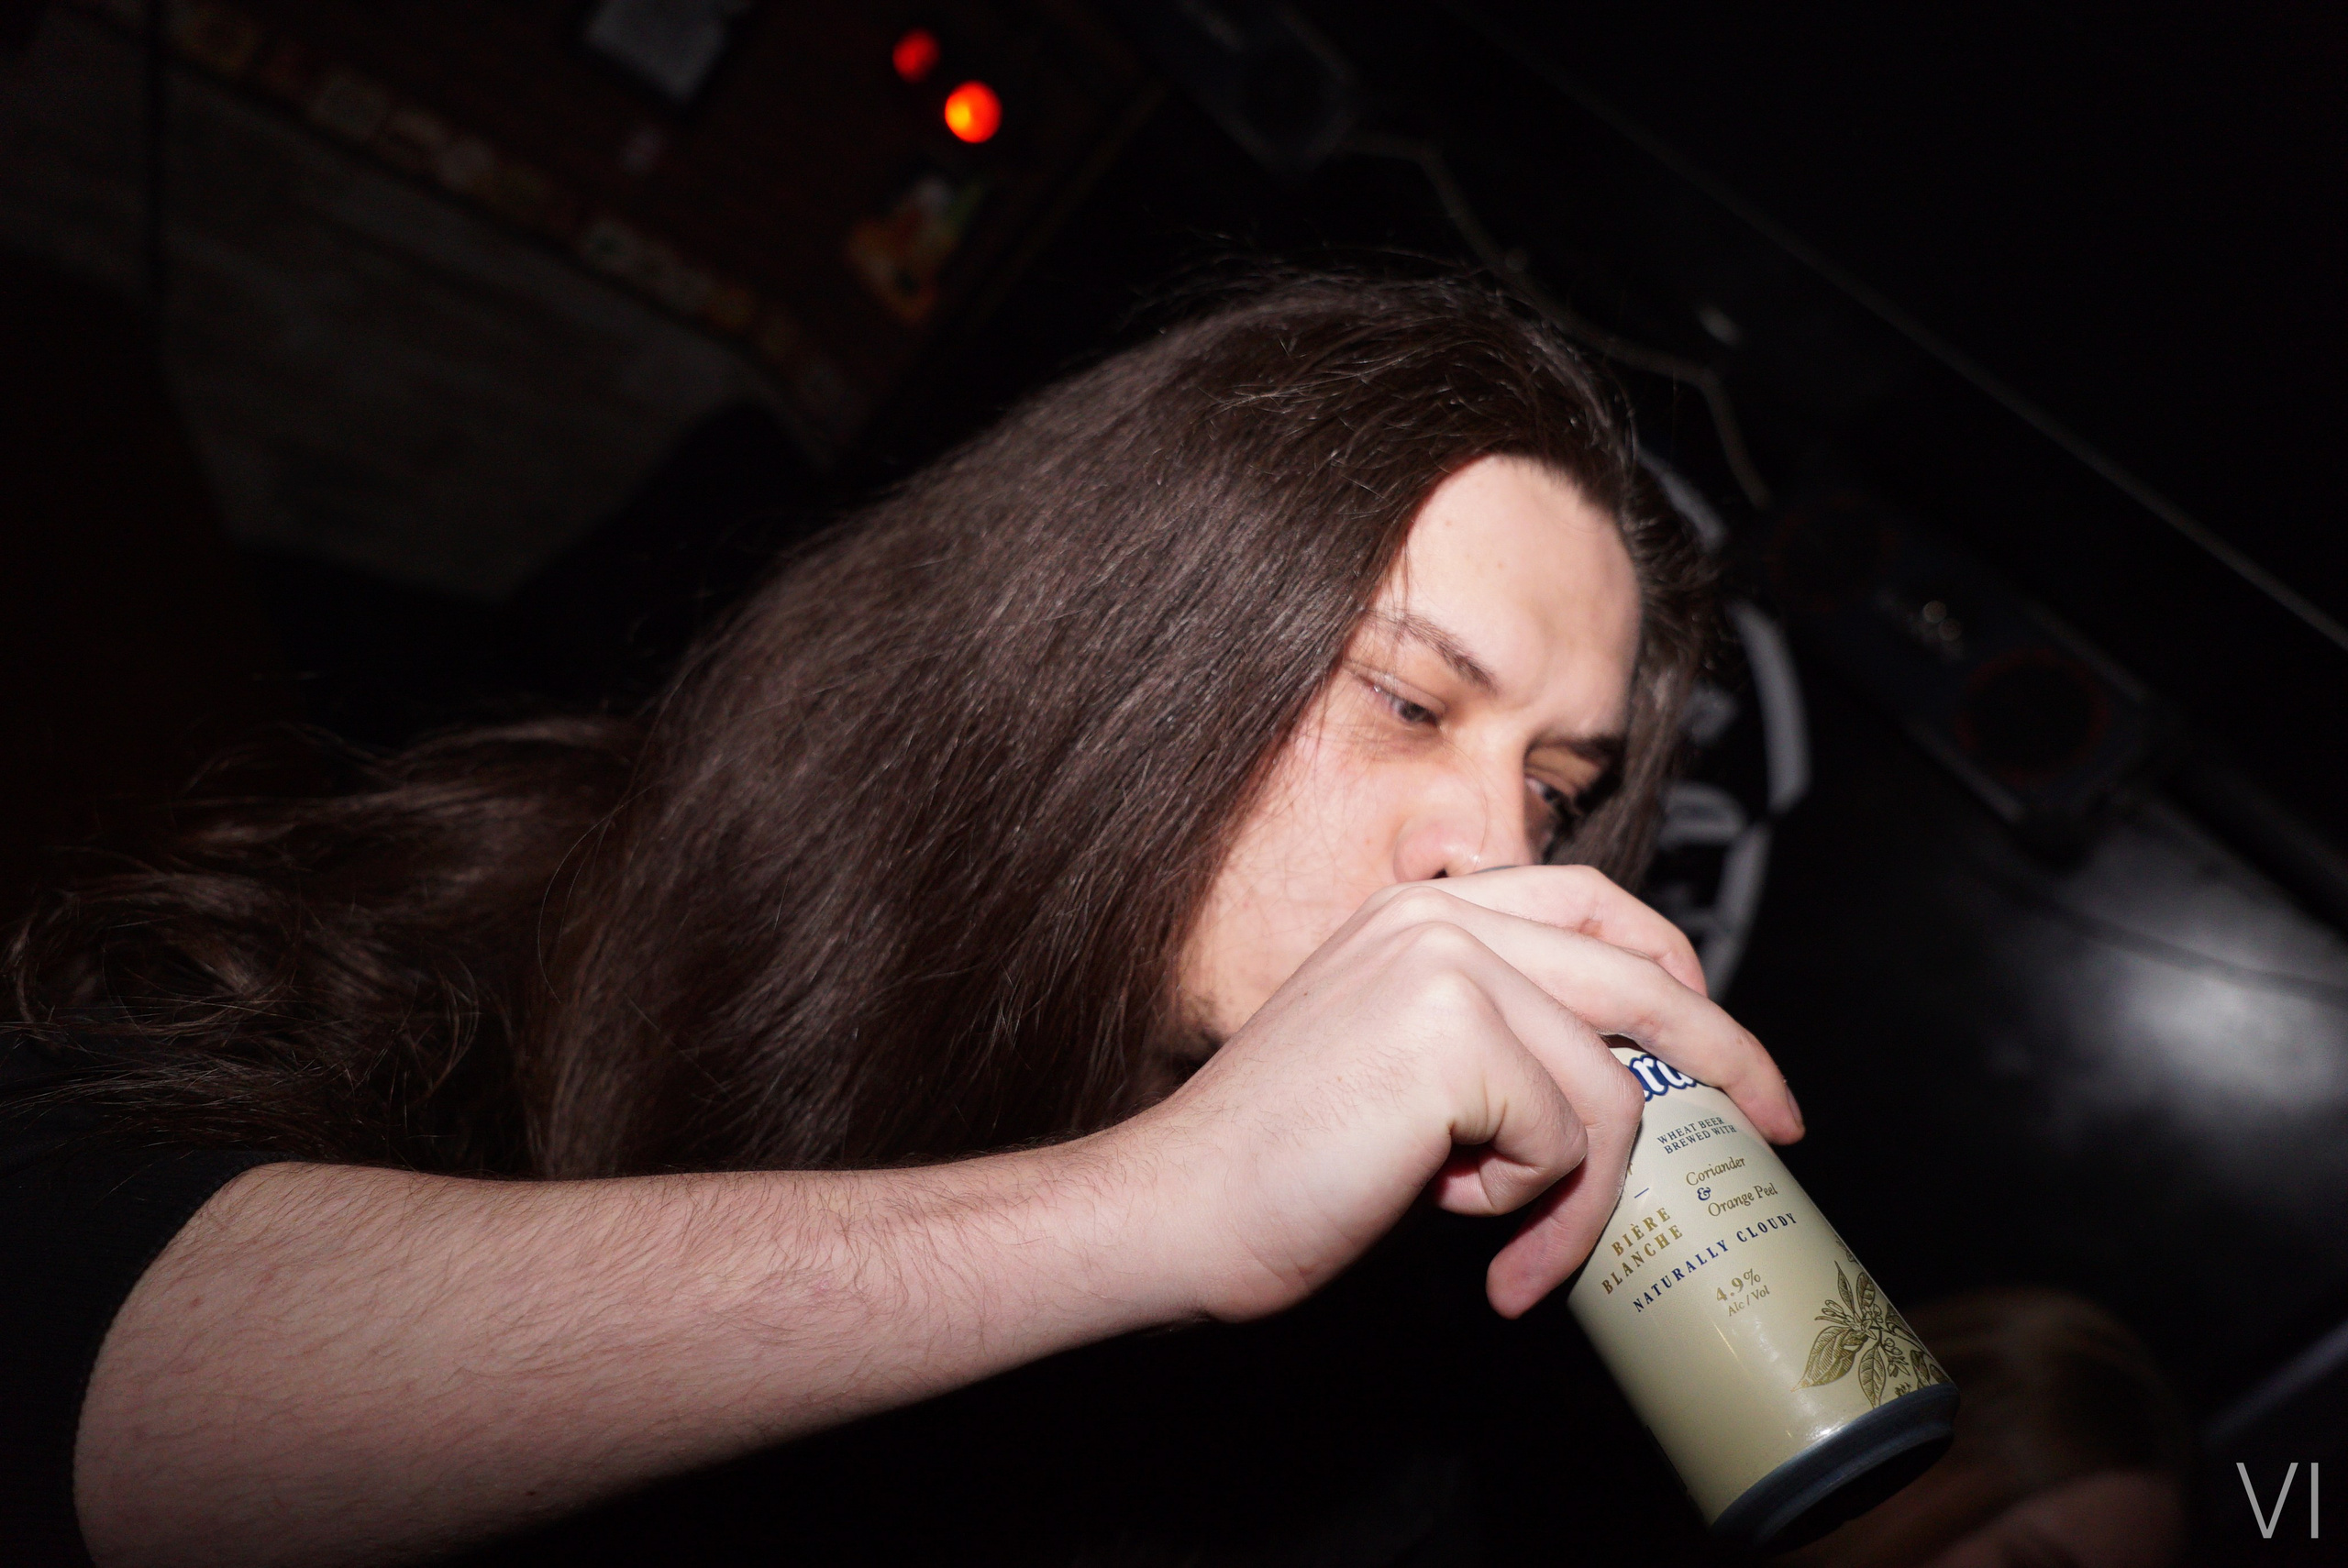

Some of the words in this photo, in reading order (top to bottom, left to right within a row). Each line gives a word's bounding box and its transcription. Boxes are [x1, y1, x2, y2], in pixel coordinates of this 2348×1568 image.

[1656, 1123, 1697, 1144] WHEAT
[1698, 1116, 1724, 1129] BEER
[1664, 1130, 1711, 1154] BREWED
[1711, 1124, 1737, 1136] WITH
[1686, 1156, 1745, 1186] Coriander
[1697, 1187, 1711, 1201] &
[1708, 1192, 1755, 1217] Orange
[1753, 1182, 1778, 1198] Peel
[1611, 1207, 1670, 1256] BIÈRE
[1601, 1224, 1683, 1295] BLANCHE
[1633, 1240, 1728, 1313] NATURALLY
[1736, 1212, 1797, 1242] CLOUDY
[1716, 1268, 1761, 1301] 4.9%
[1751, 1285, 1770, 1300] Vol
